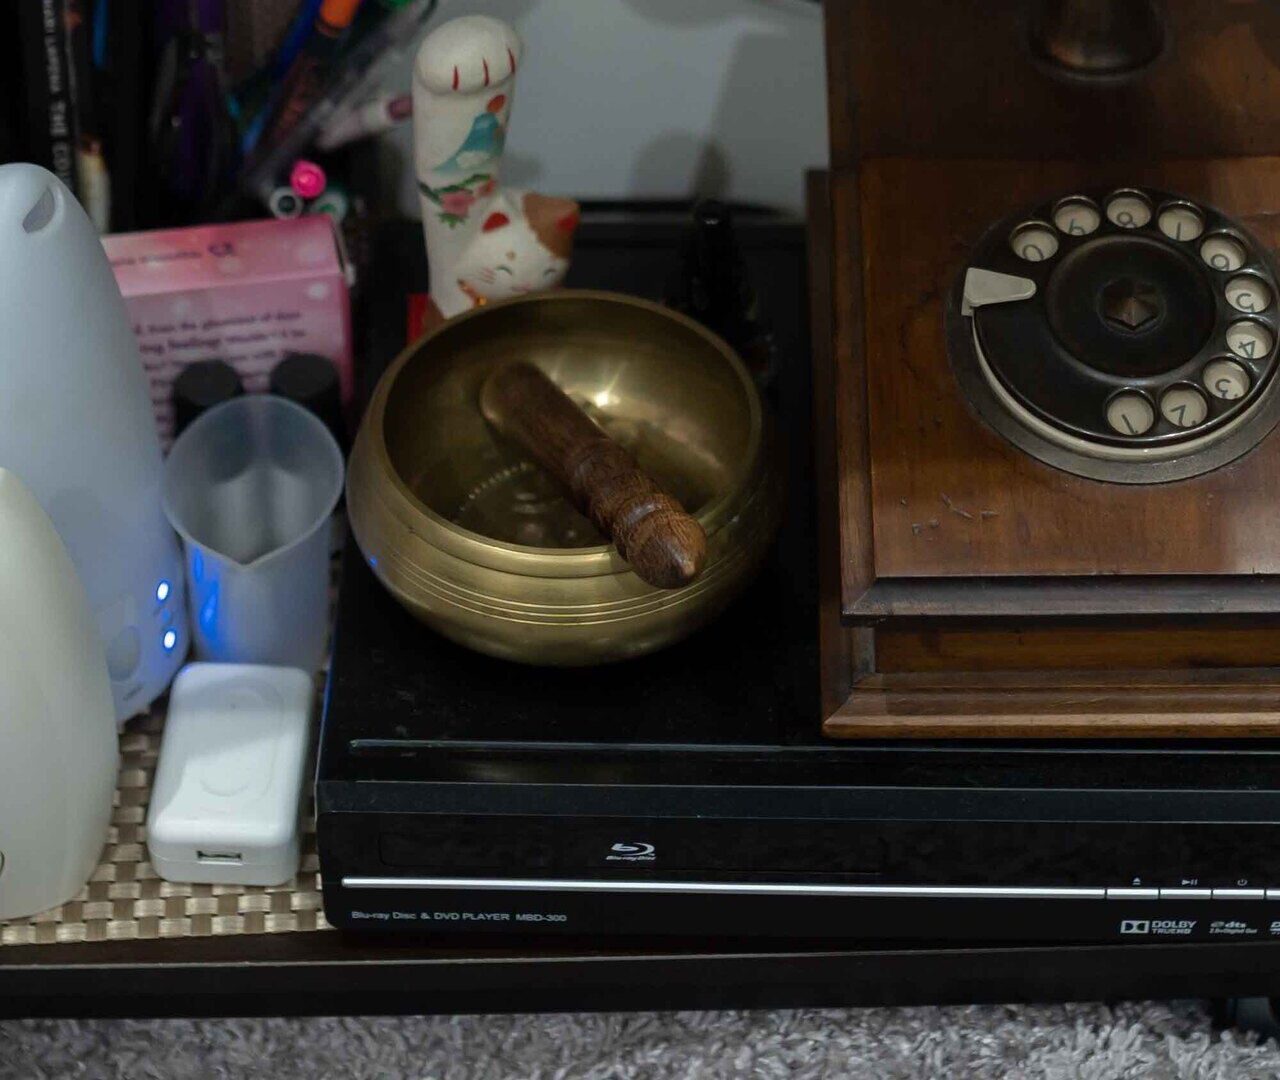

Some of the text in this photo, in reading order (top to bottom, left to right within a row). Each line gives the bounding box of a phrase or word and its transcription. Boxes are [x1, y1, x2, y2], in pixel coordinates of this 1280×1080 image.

[351, 910, 568, 922] Blu-ray Disc & DVD PLAYER MBD-300
[1151, 920, 1197, 928] DOLBY
